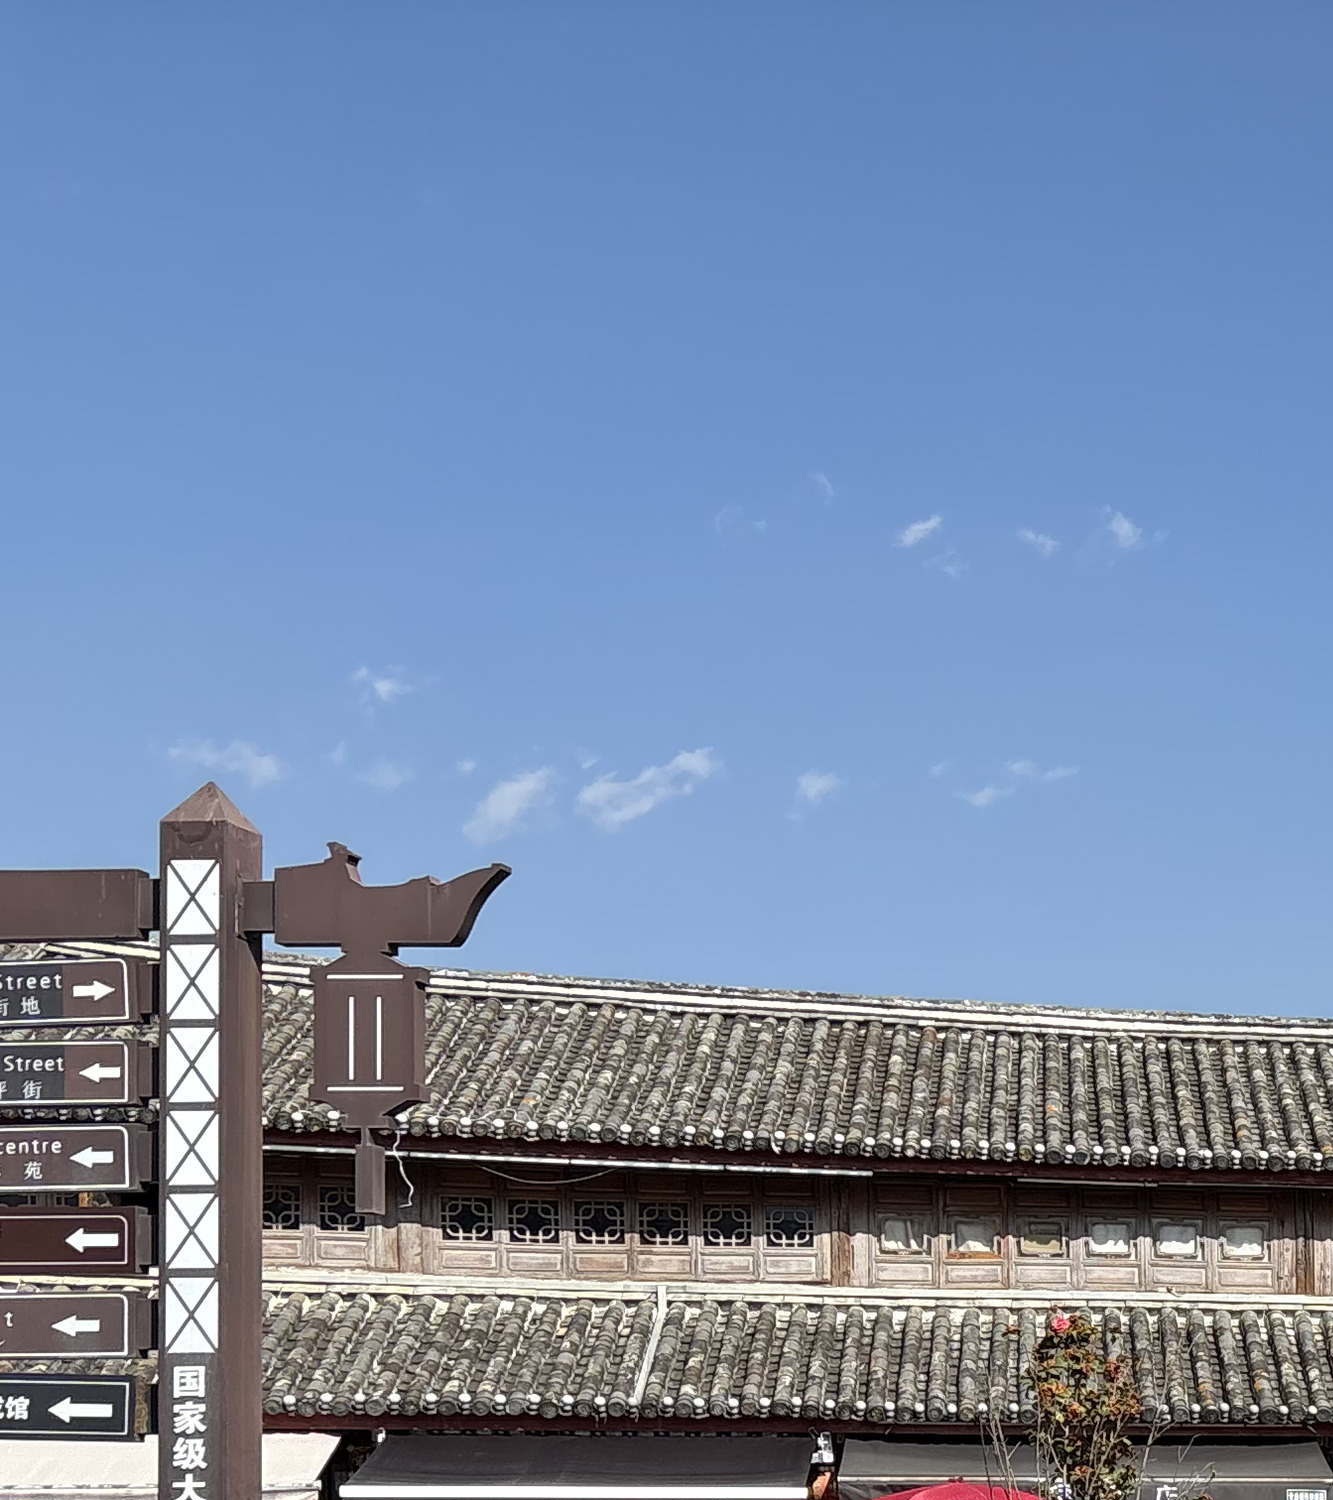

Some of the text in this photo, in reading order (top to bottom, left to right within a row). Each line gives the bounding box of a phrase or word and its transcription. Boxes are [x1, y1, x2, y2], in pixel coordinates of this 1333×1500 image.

[0, 974, 62, 991] treet
[4, 1055, 65, 1072] Street
[0, 1395, 30, 1421] 馆
